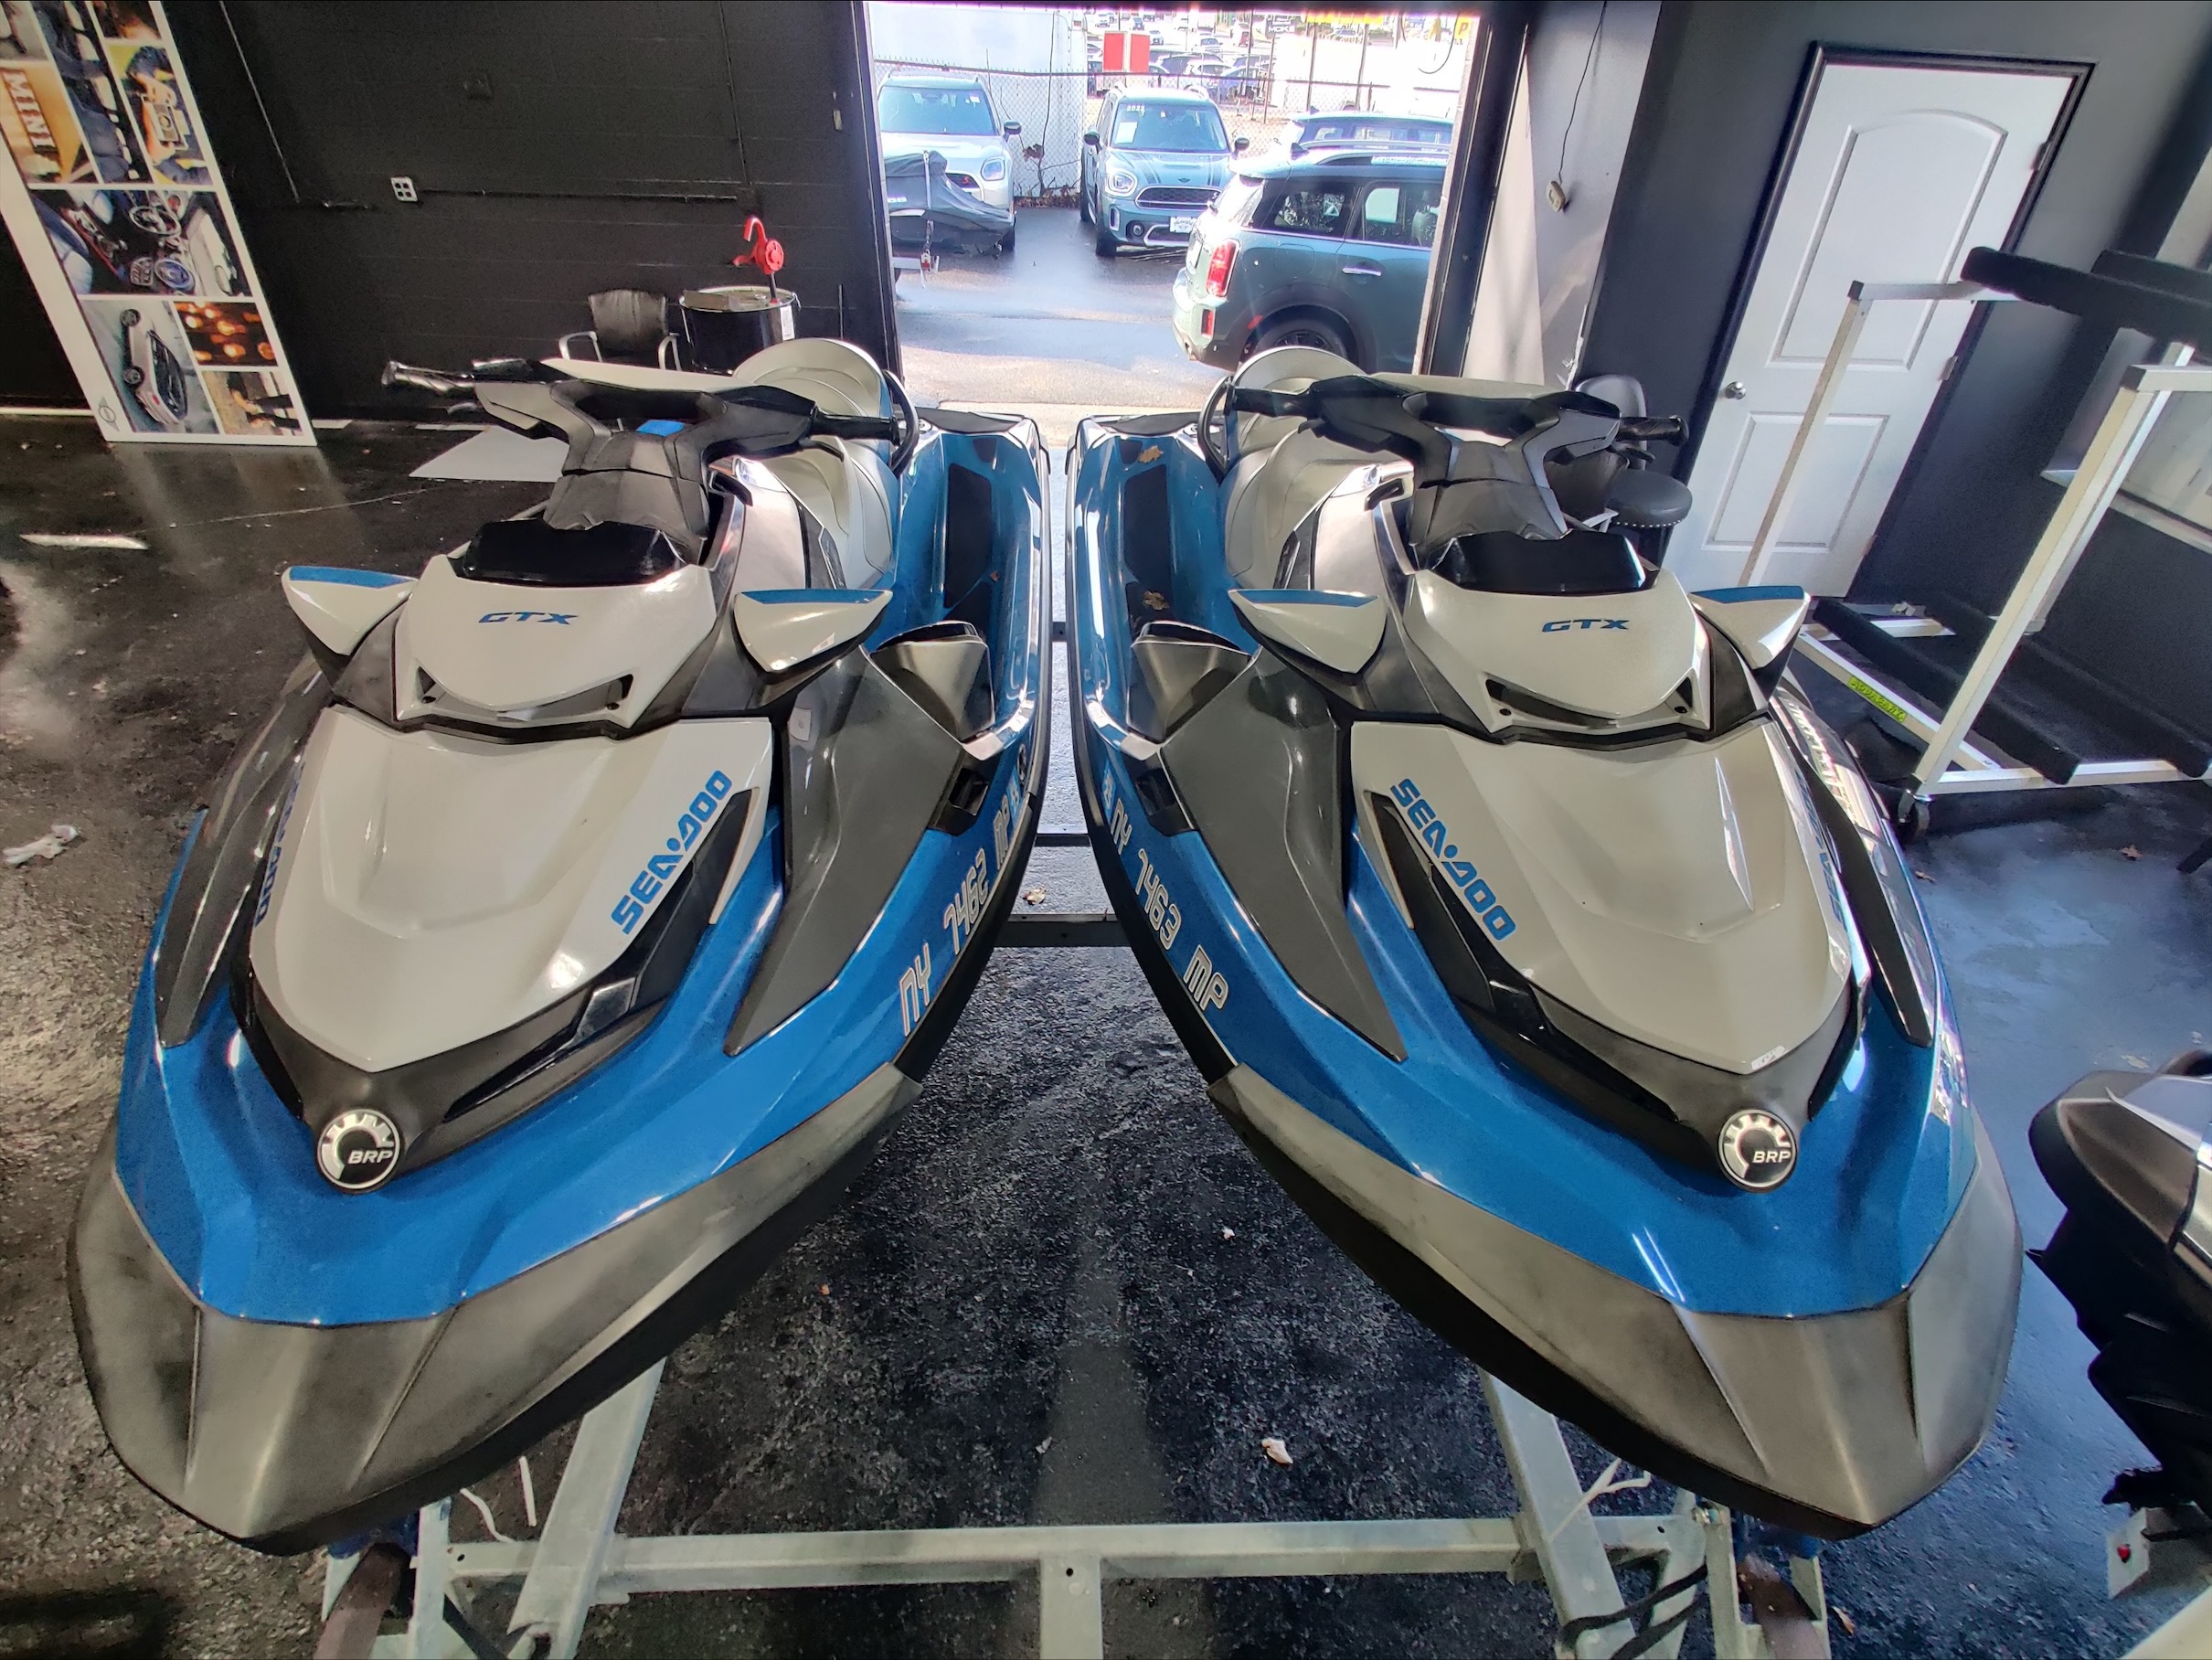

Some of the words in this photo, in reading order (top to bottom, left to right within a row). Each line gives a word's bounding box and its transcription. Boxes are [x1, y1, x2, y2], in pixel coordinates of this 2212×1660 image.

[3, 72, 56, 148] MINI
[478, 612, 579, 625] GTX
[1542, 619, 1630, 633] GTX
[1111, 798, 1132, 855] NY
[1135, 848, 1182, 951] 7463
[1183, 944, 1228, 1011] MP
[899, 942, 931, 1037] NY
[944, 847, 988, 955] 7462
[347, 1150, 393, 1165] BRP
[1752, 1150, 1791, 1165] BRP
